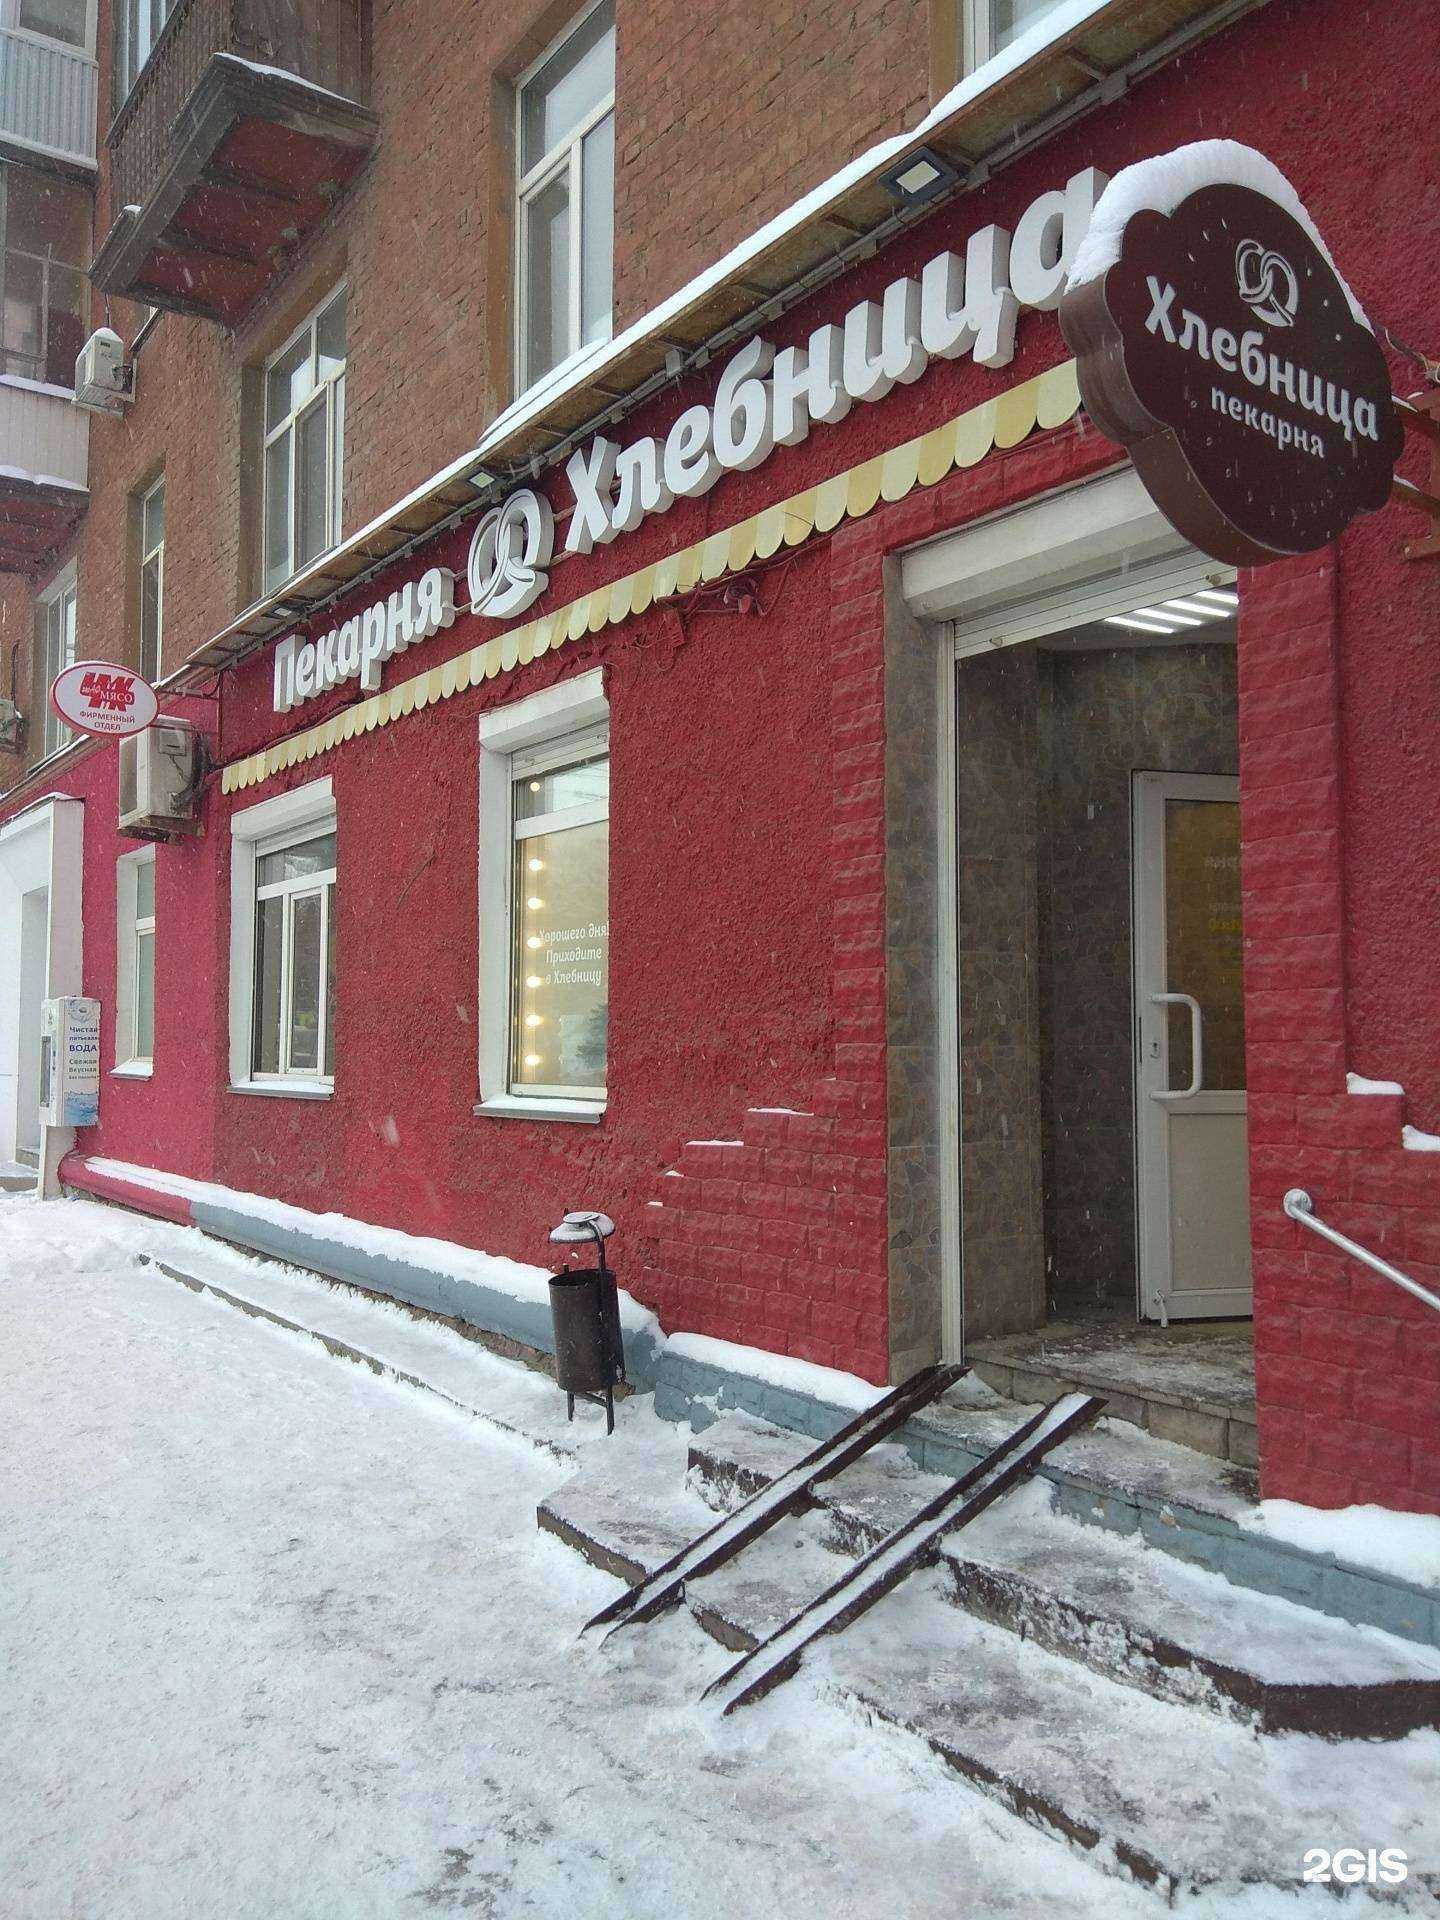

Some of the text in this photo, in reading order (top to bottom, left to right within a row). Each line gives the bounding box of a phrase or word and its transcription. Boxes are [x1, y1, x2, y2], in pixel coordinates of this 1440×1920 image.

[1144, 275, 1380, 442] Хлебница
[1211, 385, 1326, 460] пекарня
[273, 166, 1110, 714] Пекарня Хлебница
[100, 690, 133, 703] МЯСО
[80, 711, 135, 724] ФИРМЕННЫЙ
[94, 721, 121, 732] ОТДЕЛ
[546, 946, 602, 967] Приходите
[554, 968, 602, 986] Хлебницу
[69, 1044, 97, 1053] ВОДА
